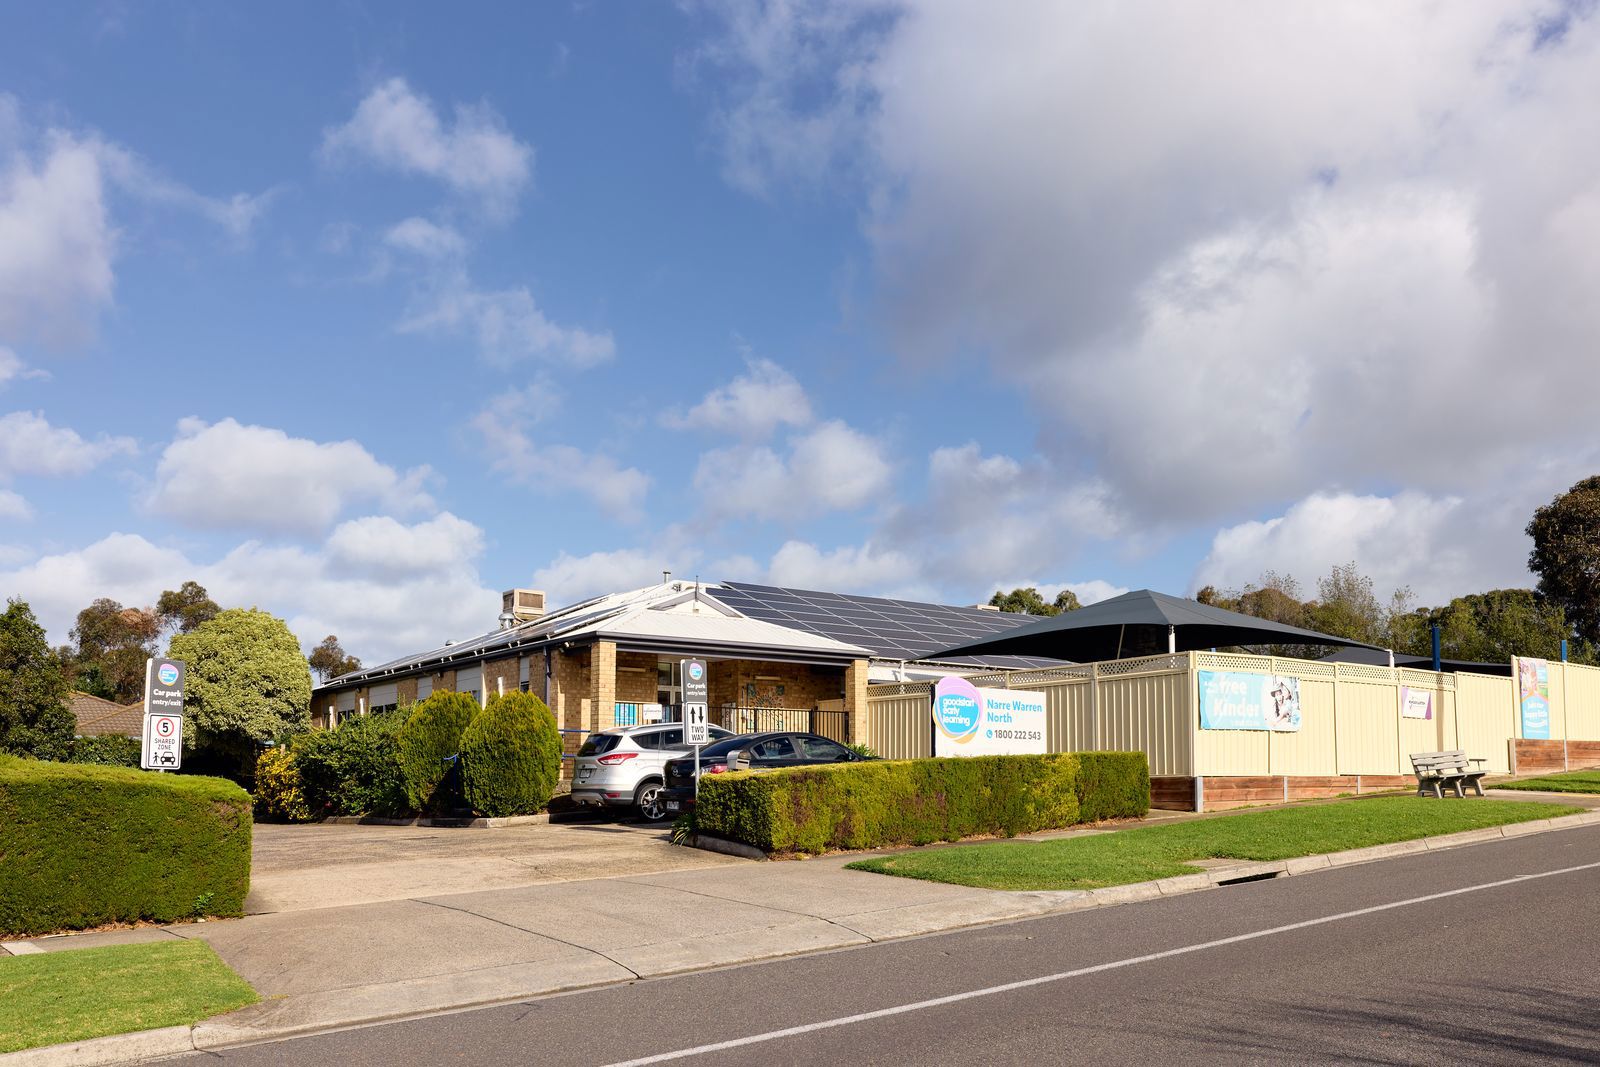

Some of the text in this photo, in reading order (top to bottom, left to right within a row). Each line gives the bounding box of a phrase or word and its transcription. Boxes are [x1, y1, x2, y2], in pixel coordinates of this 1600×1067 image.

[153, 689, 182, 698] Car park
[152, 699, 182, 707] entry/exit
[987, 699, 1043, 712] Narre Warren
[1213, 697, 1260, 717] Kinder
[943, 706, 960, 716] early
[943, 715, 970, 727] learning
[987, 713, 1013, 723] North
[162, 722, 169, 733] 5
[994, 729, 1041, 741] 1800 222 543
